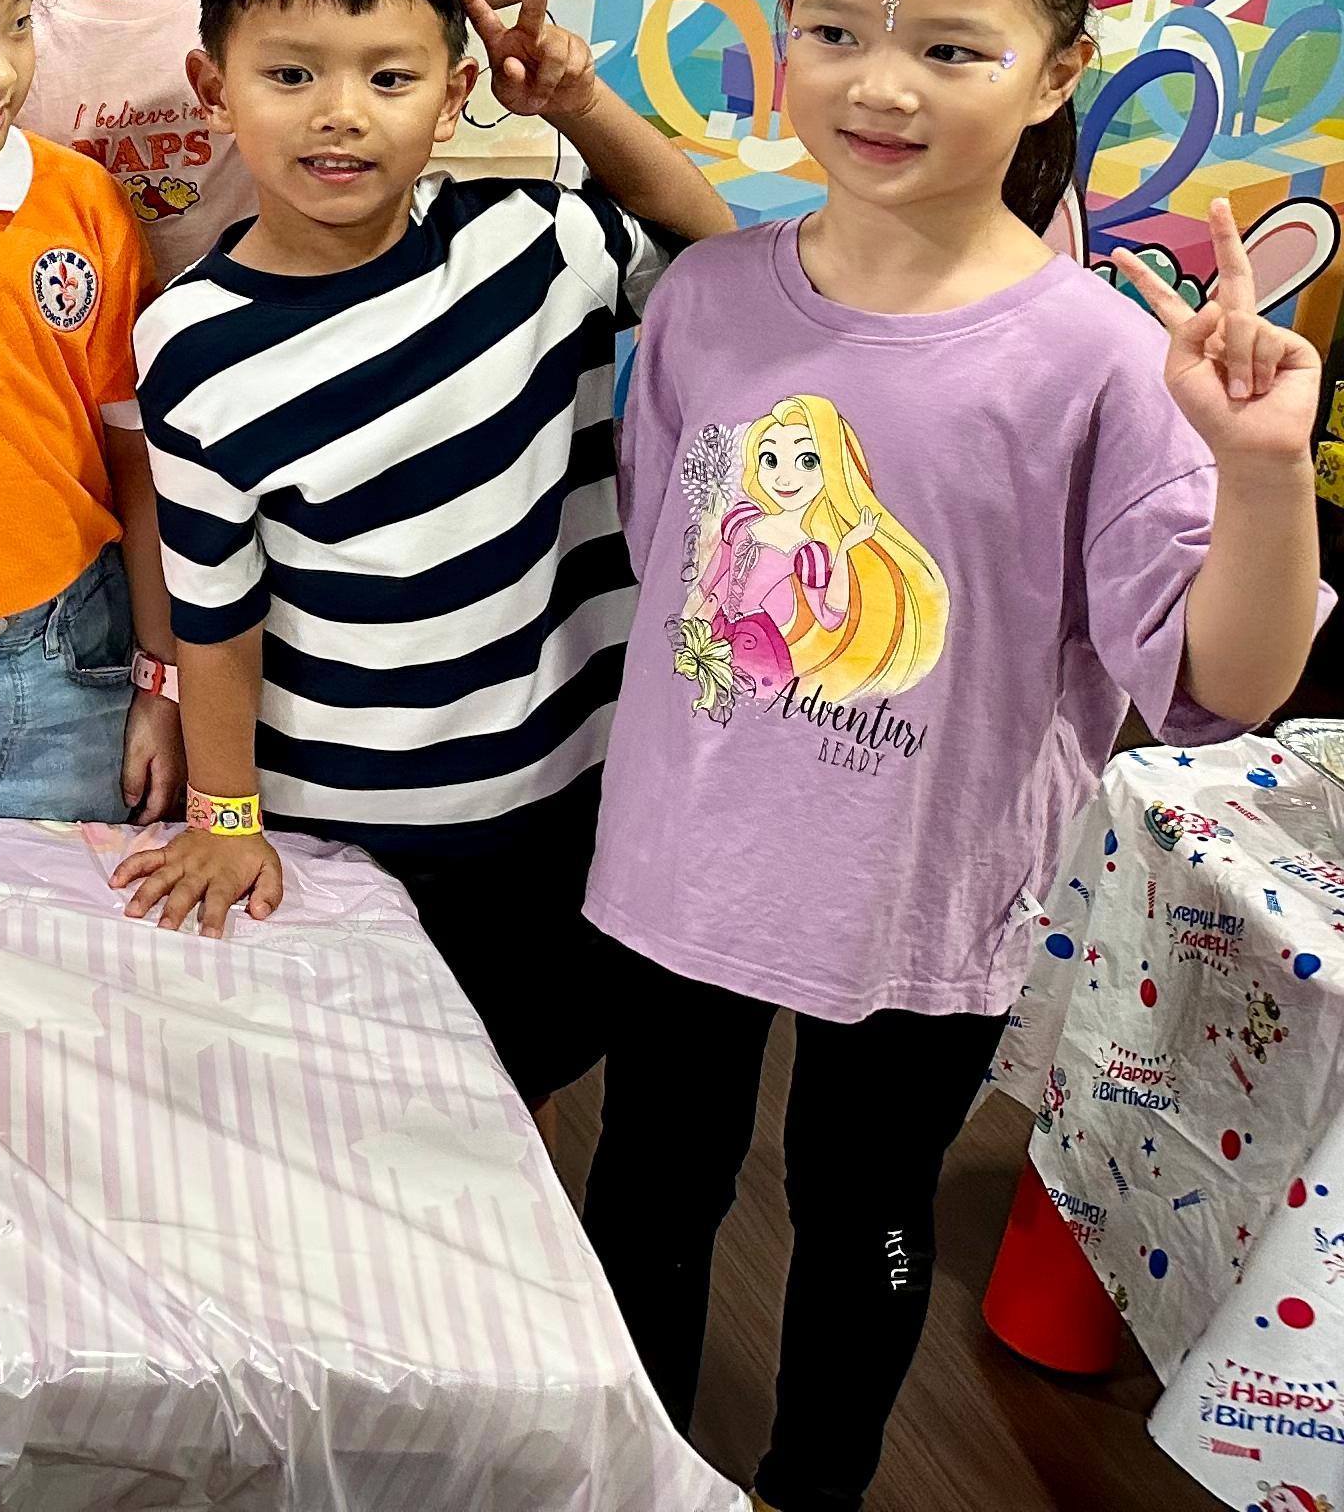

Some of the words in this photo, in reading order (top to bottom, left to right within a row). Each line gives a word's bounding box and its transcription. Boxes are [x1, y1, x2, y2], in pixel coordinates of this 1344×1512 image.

[74, 103, 87, 129] I
[96, 100, 179, 129] believe
[71, 129, 212, 174] NAPS
[764, 676, 928, 758] Adventur
[1172, 905, 1236, 936] Birthday
[1107, 1060, 1163, 1085] Happy
[1099, 1081, 1172, 1110] Birthday
[1230, 1380, 1335, 1413] Happy
